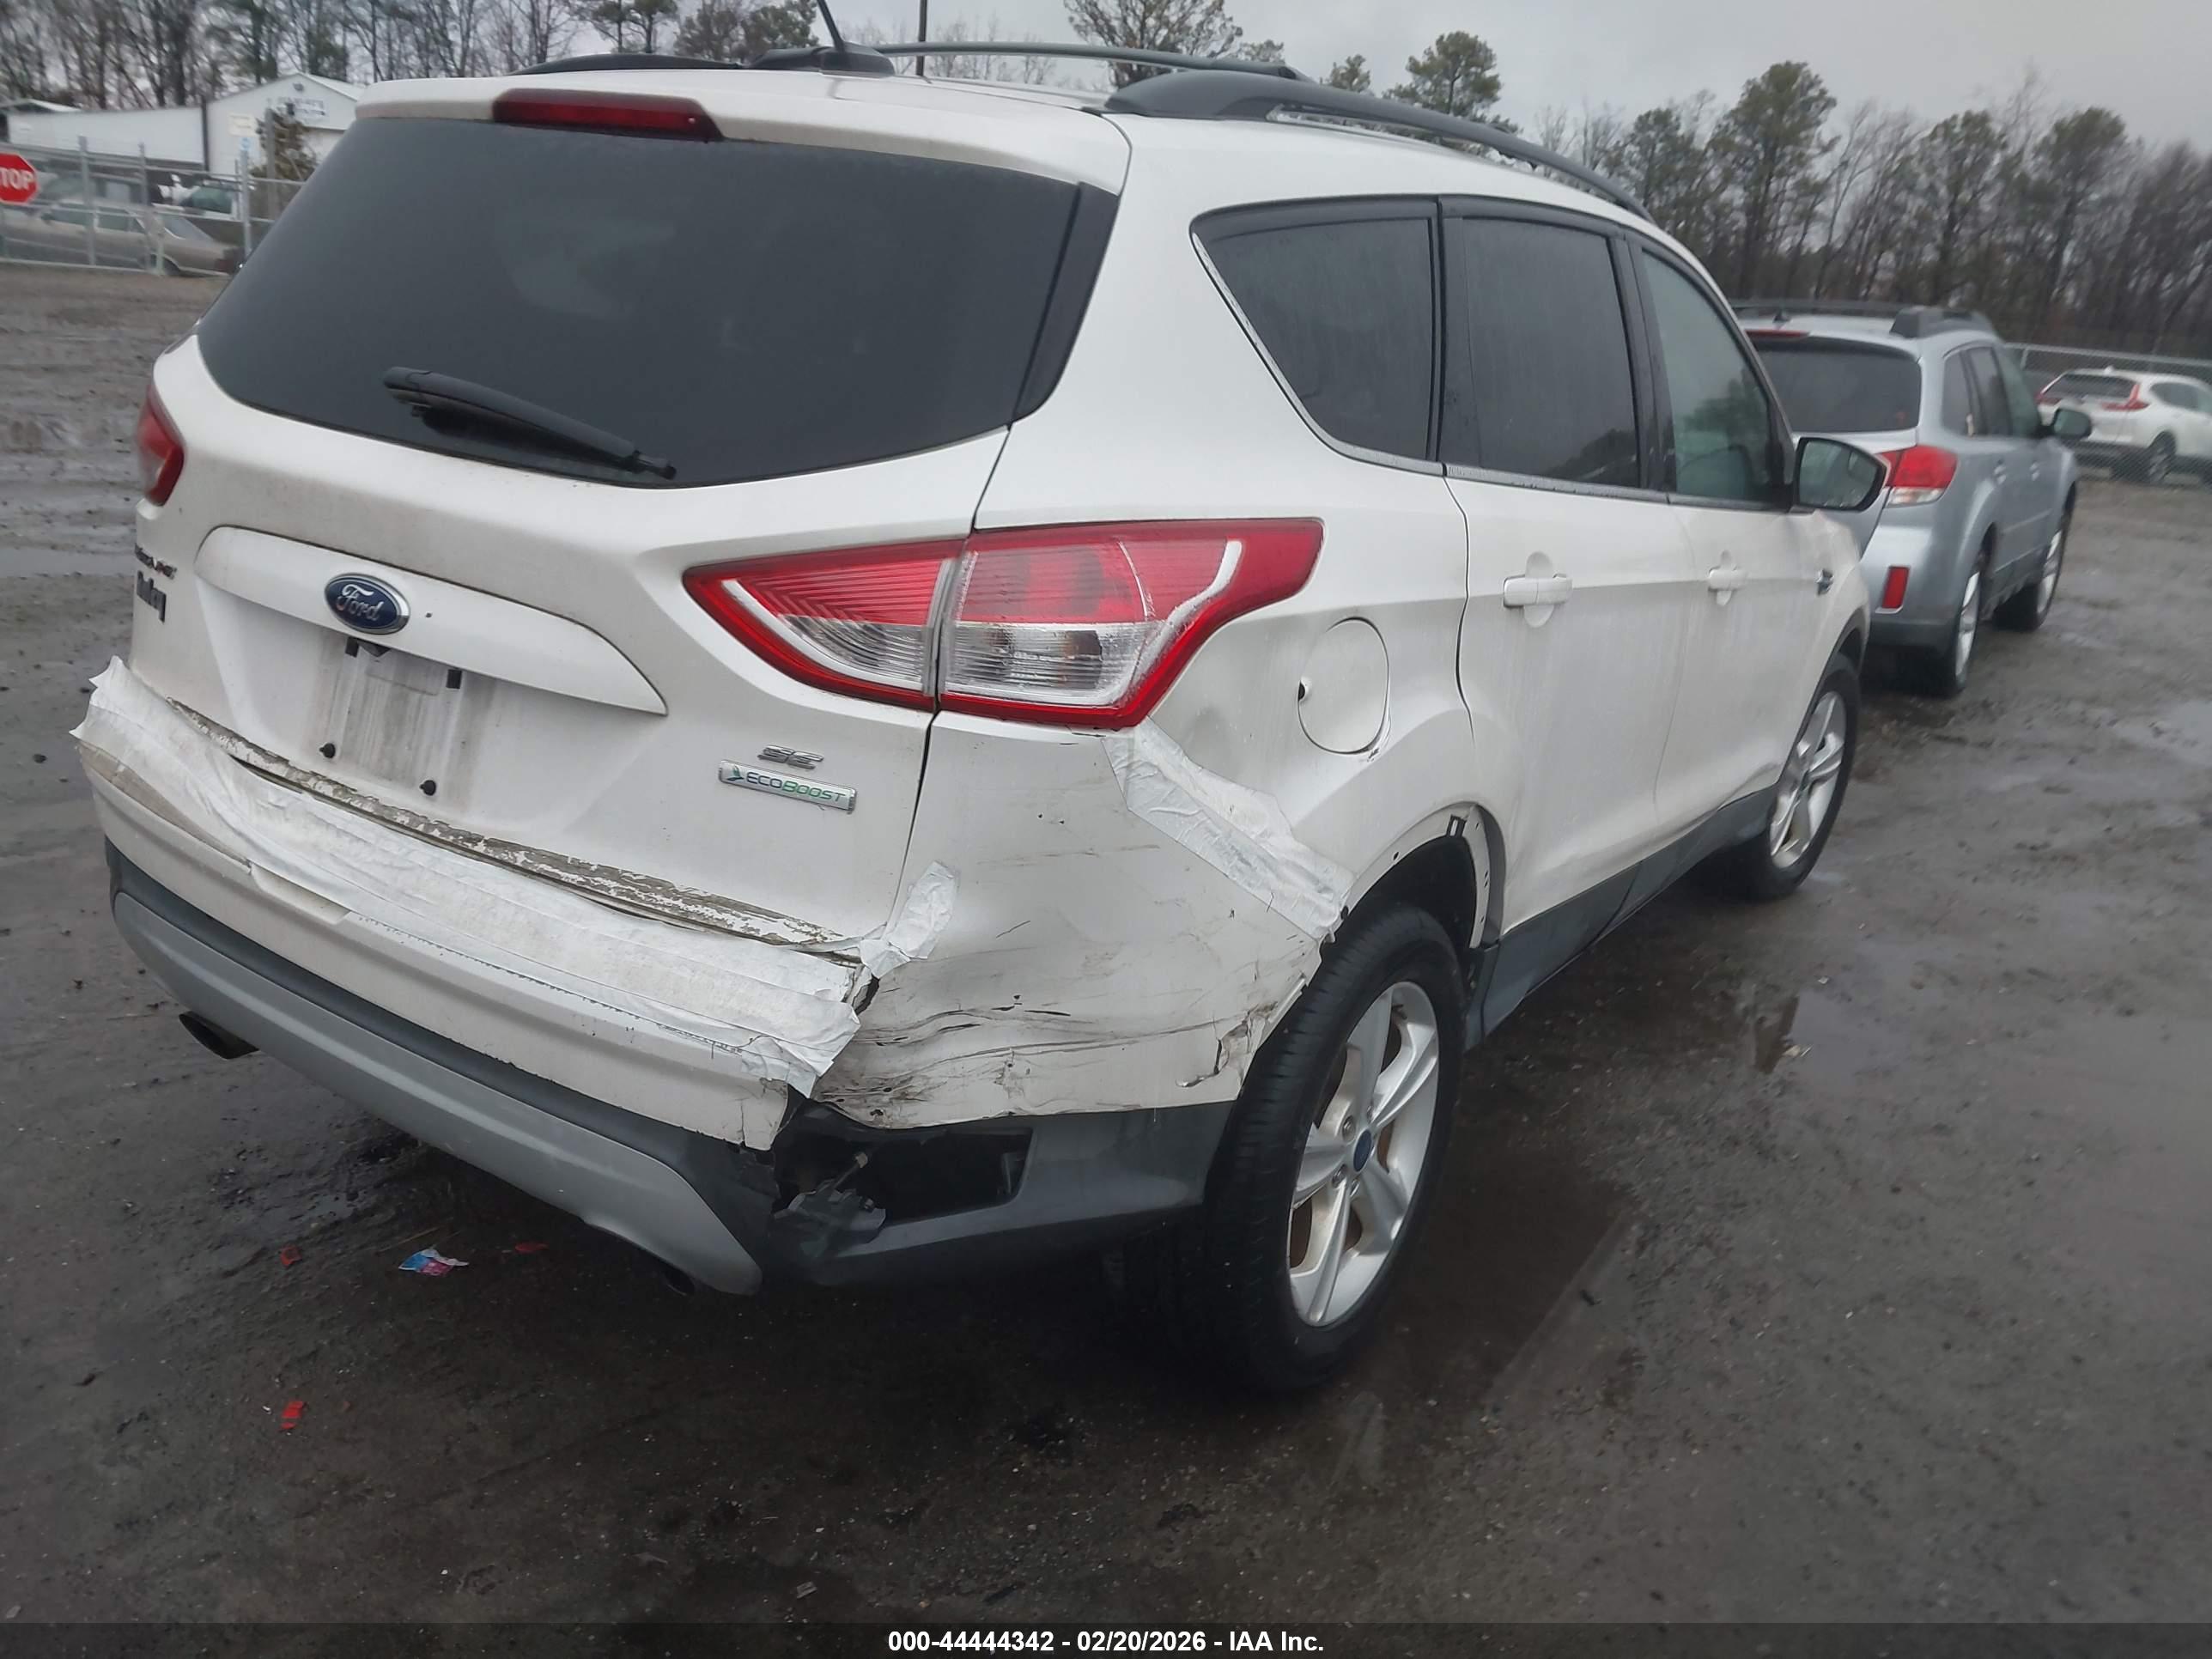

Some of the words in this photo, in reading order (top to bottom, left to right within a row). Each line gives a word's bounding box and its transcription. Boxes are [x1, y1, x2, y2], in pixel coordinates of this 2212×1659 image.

[0, 167, 33, 190] TOP
[336, 584, 384, 621] Ford
[757, 744, 824, 770] SE
[746, 771, 846, 802] ECOBOOST
